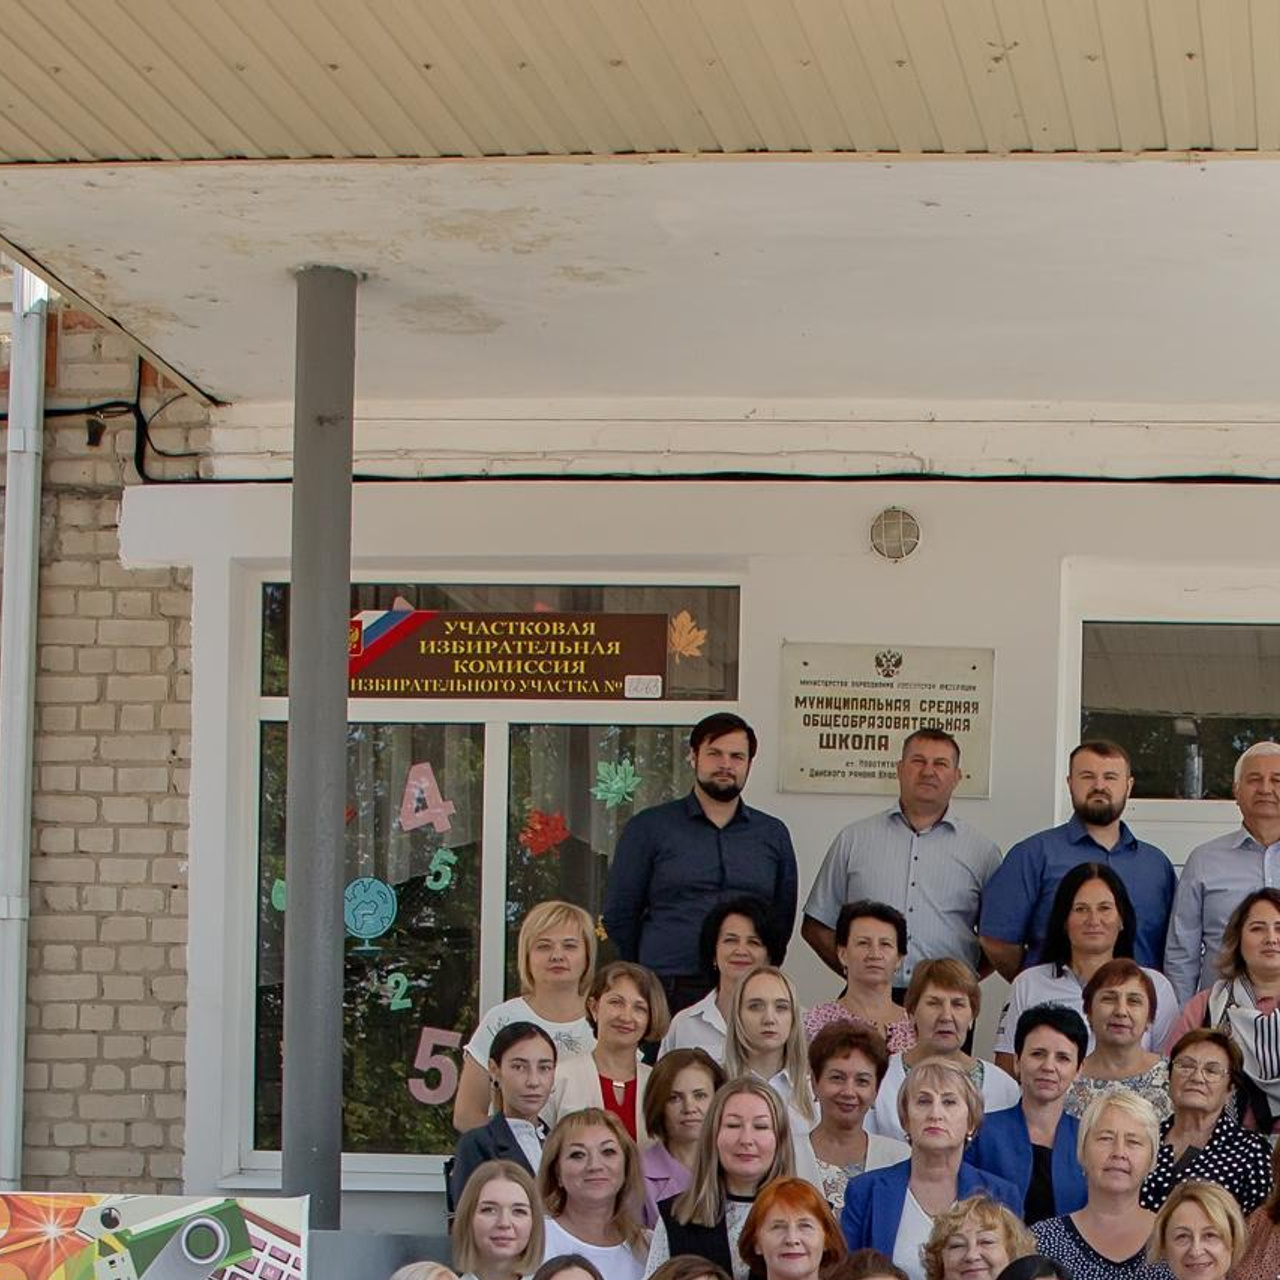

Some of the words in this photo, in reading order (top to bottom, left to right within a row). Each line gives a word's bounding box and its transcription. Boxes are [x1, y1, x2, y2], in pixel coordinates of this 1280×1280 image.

[444, 620, 596, 636] УЧАСТКОВАЯ
[419, 640, 621, 656] ИЗБИРАТЕЛЬНАЯ
[453, 659, 586, 674] КОМИССИЯ
[350, 677, 516, 692] ИЗБИРАТЕЛЬНОГО
[518, 679, 600, 693] УЧАСТКА
[603, 680, 623, 693] №
[794, 695, 911, 712] МУНИЦИПАЛЬНАЯ
[919, 699, 980, 715] СРЕДНЯЯ
[802, 713, 971, 732] ОБЩЕОБРАЗОВАТЕЛЬНАЯ
[818, 733, 890, 751] ШКОЛА
